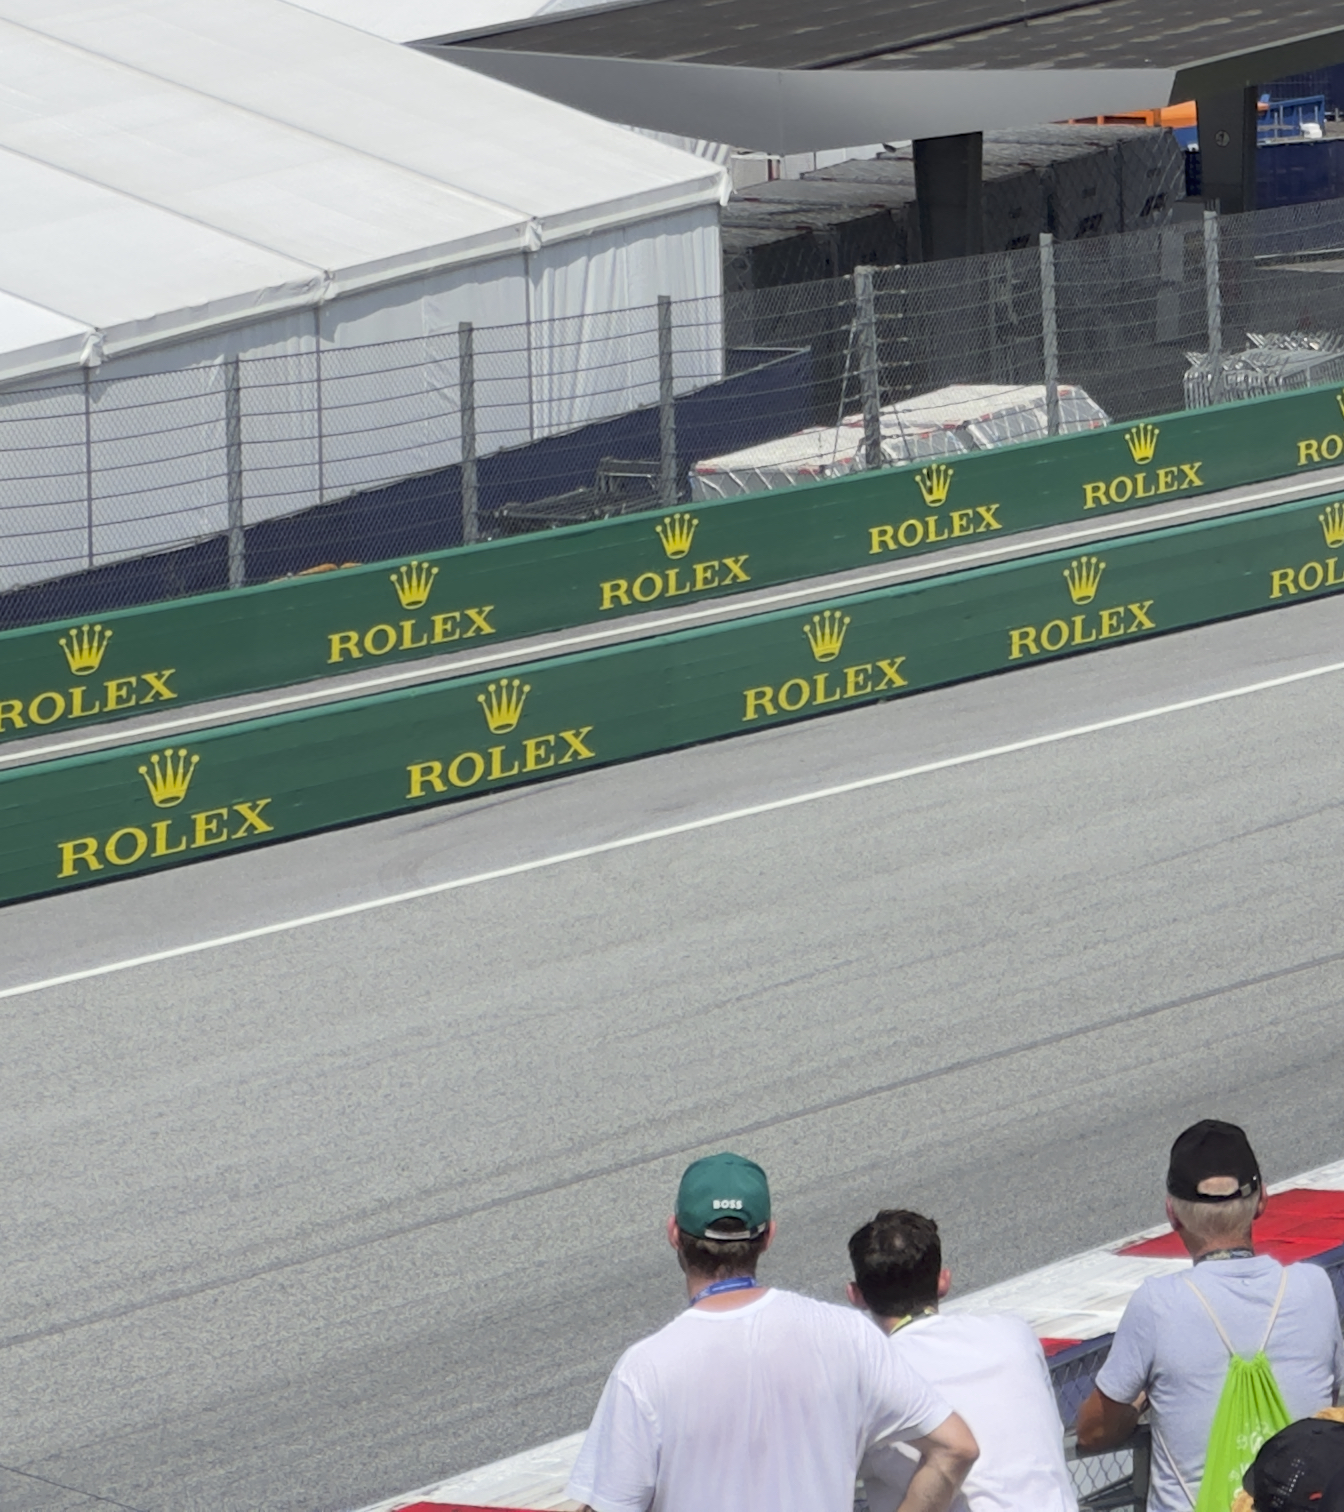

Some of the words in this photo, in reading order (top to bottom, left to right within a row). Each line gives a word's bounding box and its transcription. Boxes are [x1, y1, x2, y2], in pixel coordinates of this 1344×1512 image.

[1083, 462, 1202, 508] ROLEX
[869, 503, 1001, 553] ROLEX
[600, 554, 749, 609] ROLEX
[328, 605, 494, 662] ROLEX
[1009, 600, 1153, 658] ROLEX
[0, 669, 177, 732] ROLEX
[744, 656, 906, 719] ROLEX
[407, 725, 594, 797] ROLEX
[58, 798, 272, 877] ROLEX
[712, 1199, 743, 1210] BOSS
